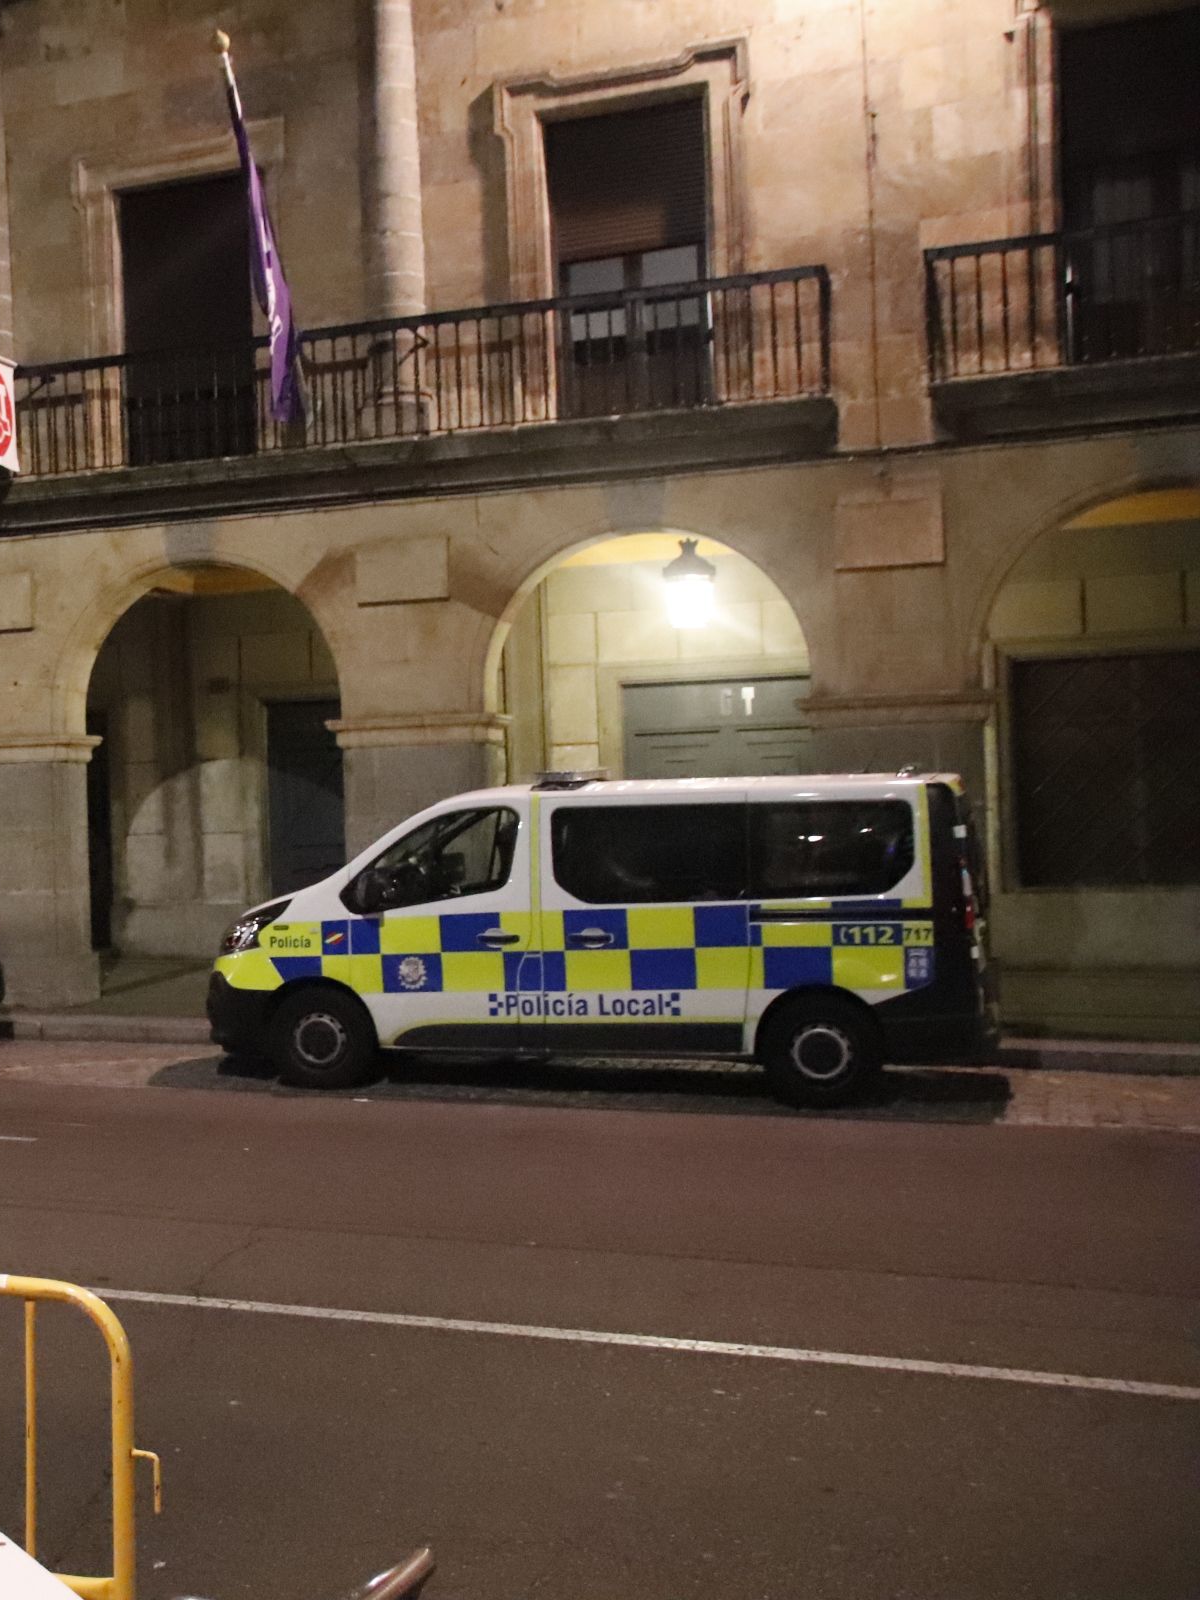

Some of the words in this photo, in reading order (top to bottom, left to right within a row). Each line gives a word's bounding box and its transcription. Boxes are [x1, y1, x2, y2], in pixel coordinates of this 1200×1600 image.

[270, 935, 311, 948] Policía
[849, 926, 894, 944] 112
[904, 928, 930, 940] 717
[505, 993, 588, 1016] Policía
[598, 993, 663, 1016] Local
